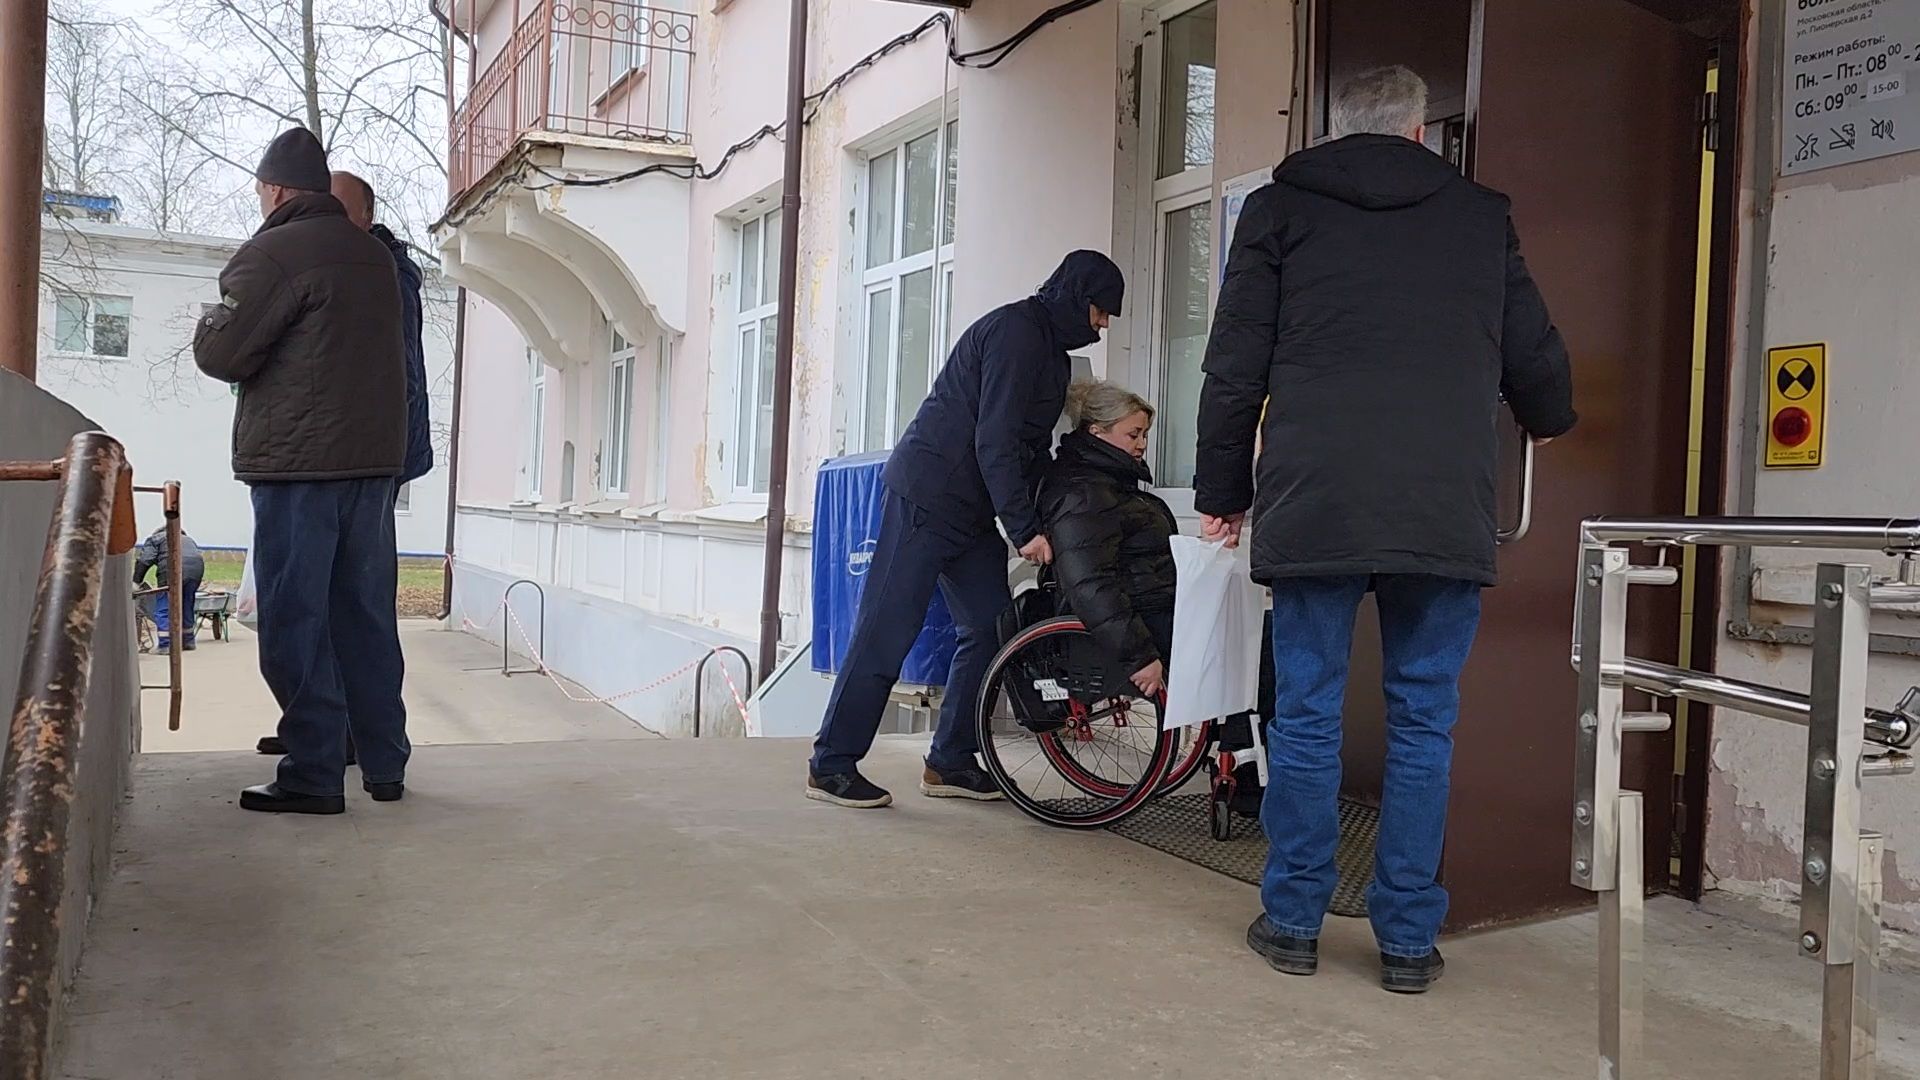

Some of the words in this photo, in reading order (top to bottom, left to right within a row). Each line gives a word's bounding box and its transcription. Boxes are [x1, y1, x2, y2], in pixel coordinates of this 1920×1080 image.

[1810, 15, 1858, 33] Пионерская
[1795, 47, 1834, 64] Режим
[1837, 35, 1885, 56] работы:
[1796, 73, 1819, 90] Пн.
[1837, 63, 1862, 80] Пт.:
[1795, 99, 1821, 118] Сб.:
[1873, 81, 1899, 94] 15-00
